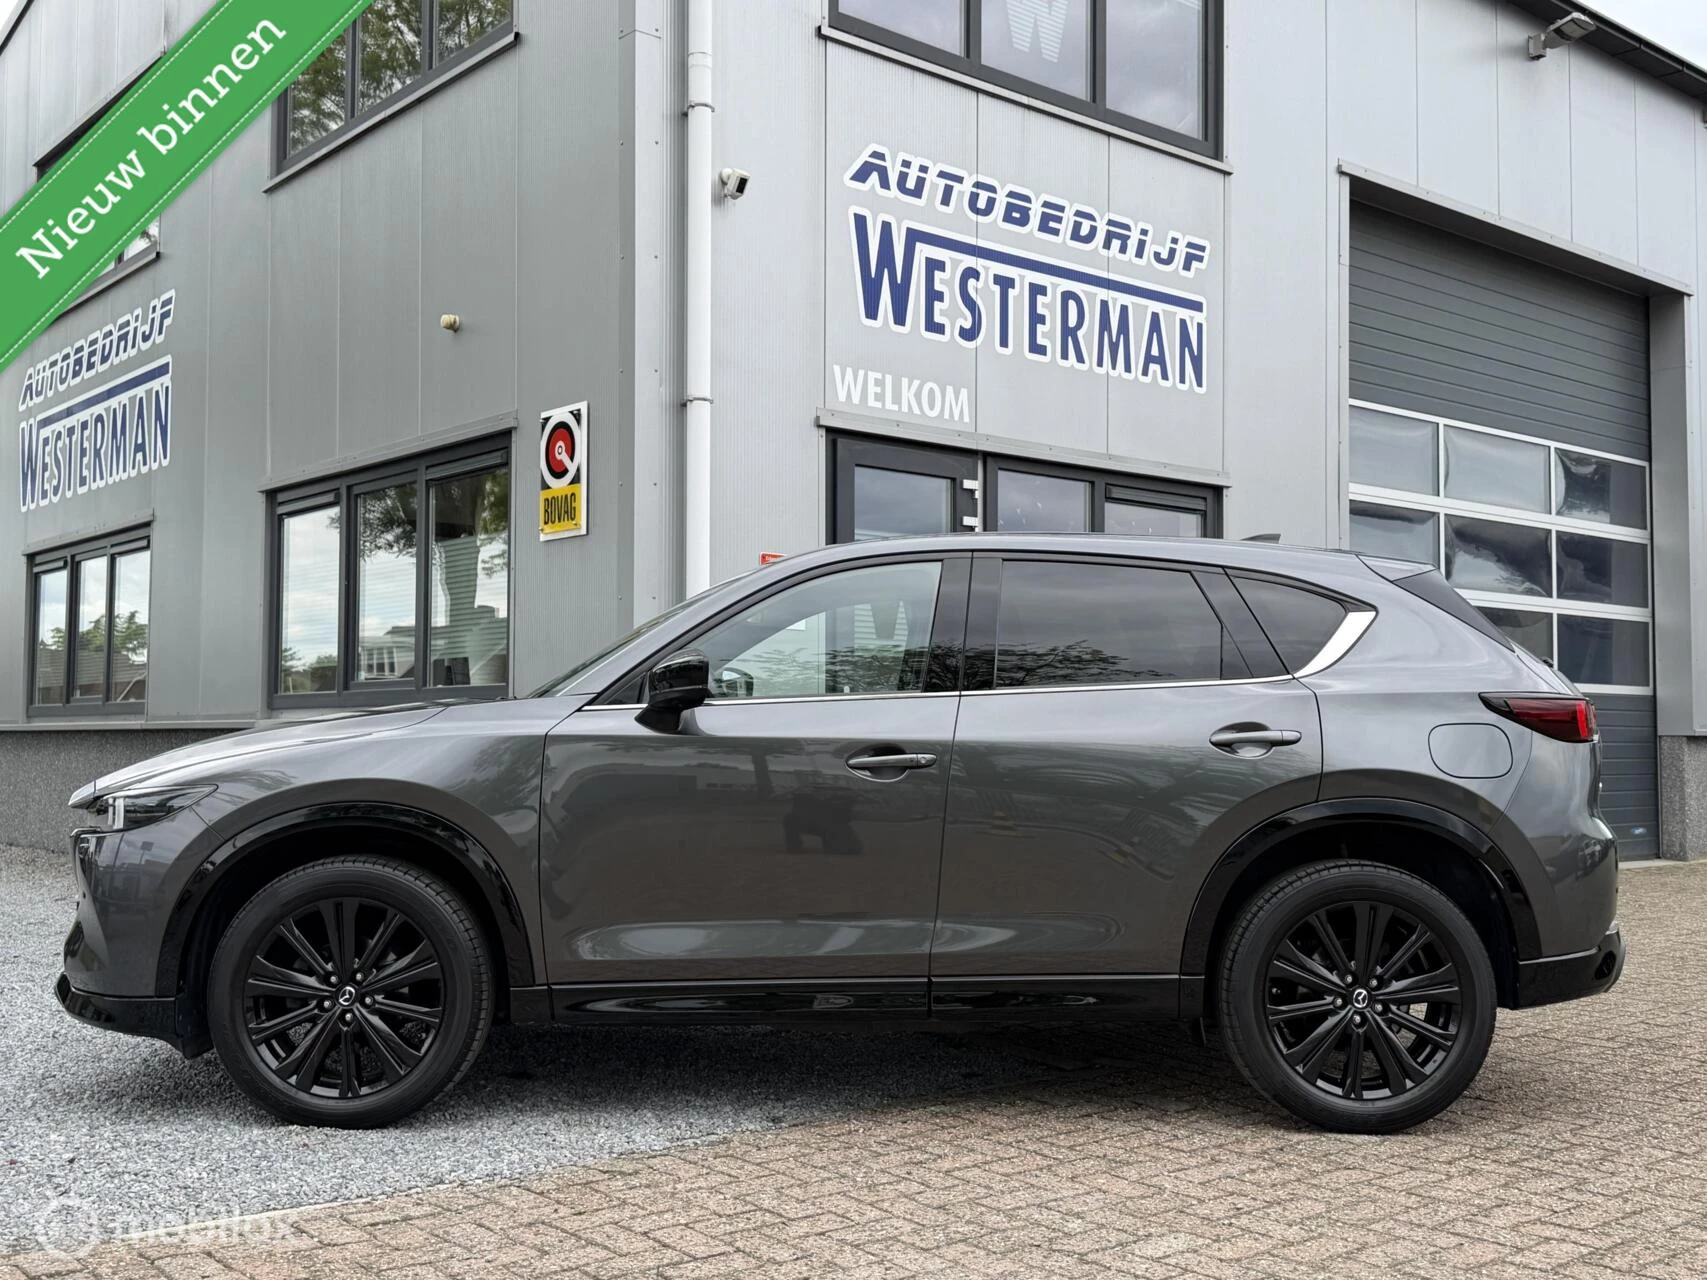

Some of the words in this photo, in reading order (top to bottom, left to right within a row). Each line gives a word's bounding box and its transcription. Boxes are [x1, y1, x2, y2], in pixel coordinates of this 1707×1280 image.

[846, 146, 1209, 276] AUTOBEDRIJF
[19, 290, 174, 408] AUTOBEDRIJF
[850, 209, 1206, 391] WESTERMAN
[20, 358, 171, 510] WESTERMAN
[833, 365, 970, 423] WELKOM
[543, 492, 576, 525] BOVAG
